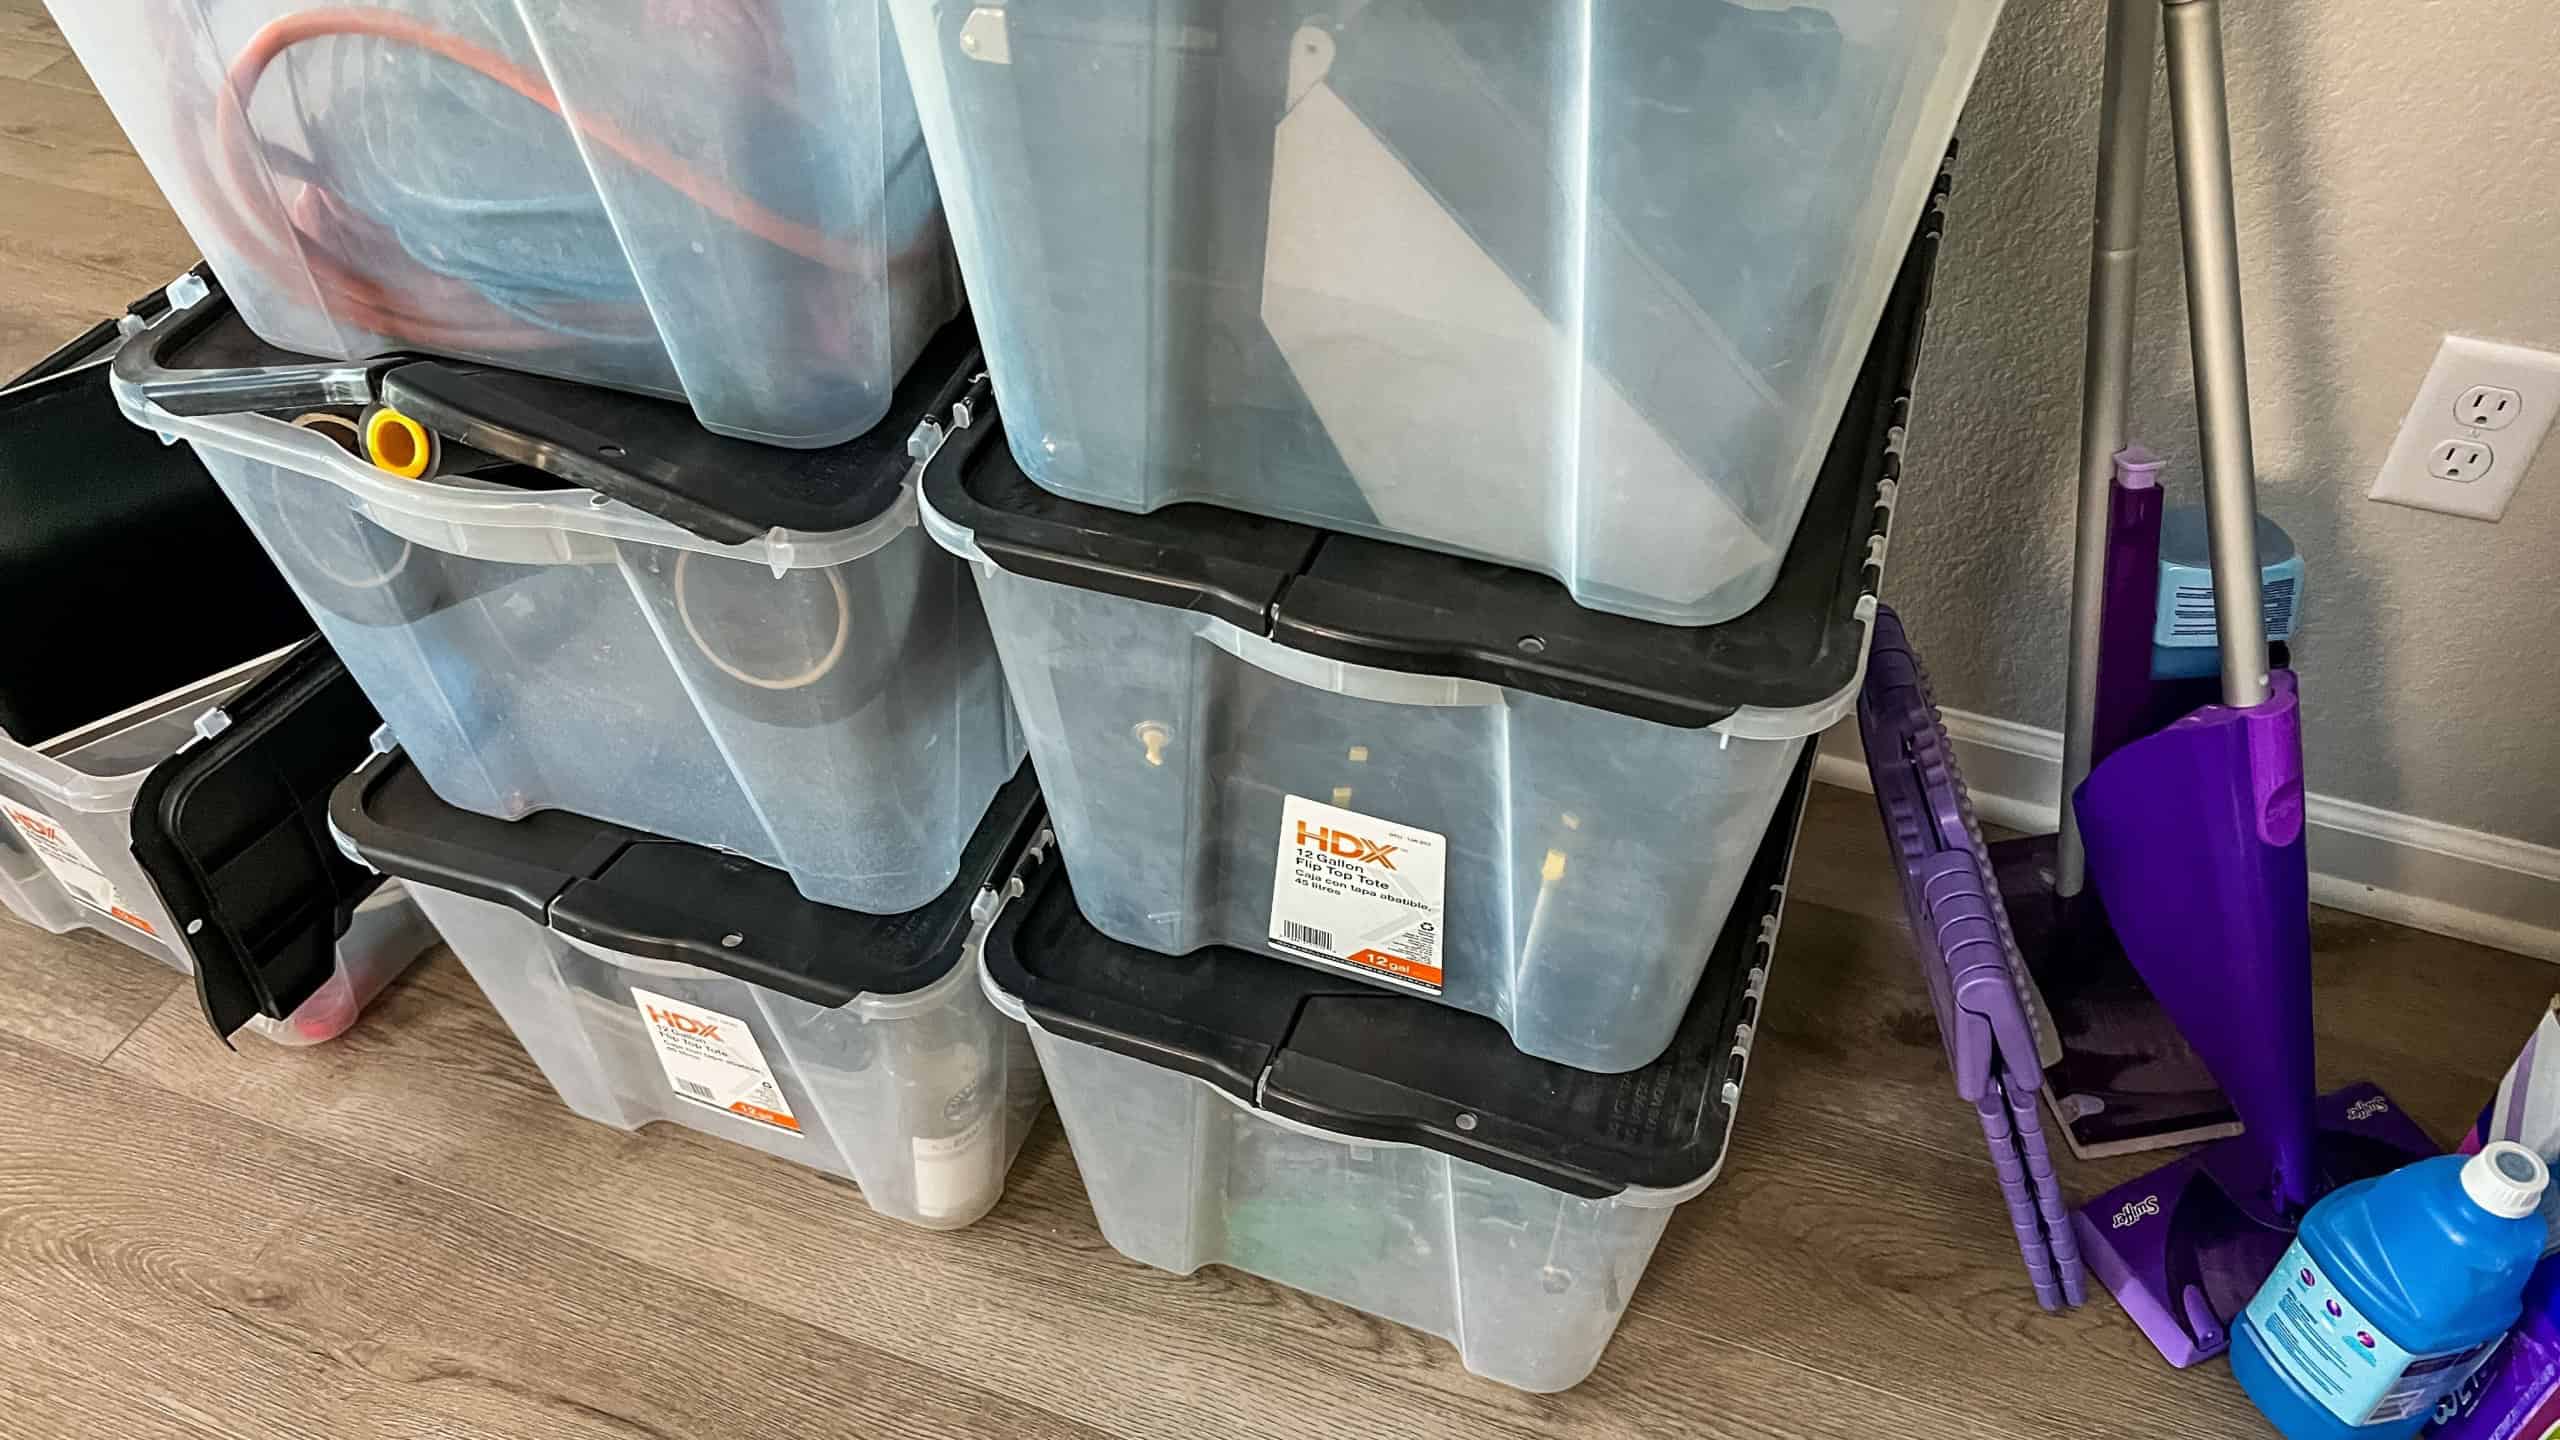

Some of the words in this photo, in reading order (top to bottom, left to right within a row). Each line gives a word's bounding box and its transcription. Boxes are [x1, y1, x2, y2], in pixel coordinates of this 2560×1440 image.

[1296, 819, 1398, 871] HDX
[1296, 857, 1322, 871] Flip
[1327, 865, 1353, 880] Top
[1357, 874, 1389, 890] Tote
[1297, 848, 1313, 859] 12
[1316, 853, 1364, 873] Gallon
[1311, 882, 1341, 896] litros
[1325, 878, 1347, 889] con
[1350, 884, 1377, 897] tapa
[1367, 953, 1388, 967] 12
[646, 1004, 724, 1041] HDX
[2112, 1195, 2160, 1229] Swiffer
